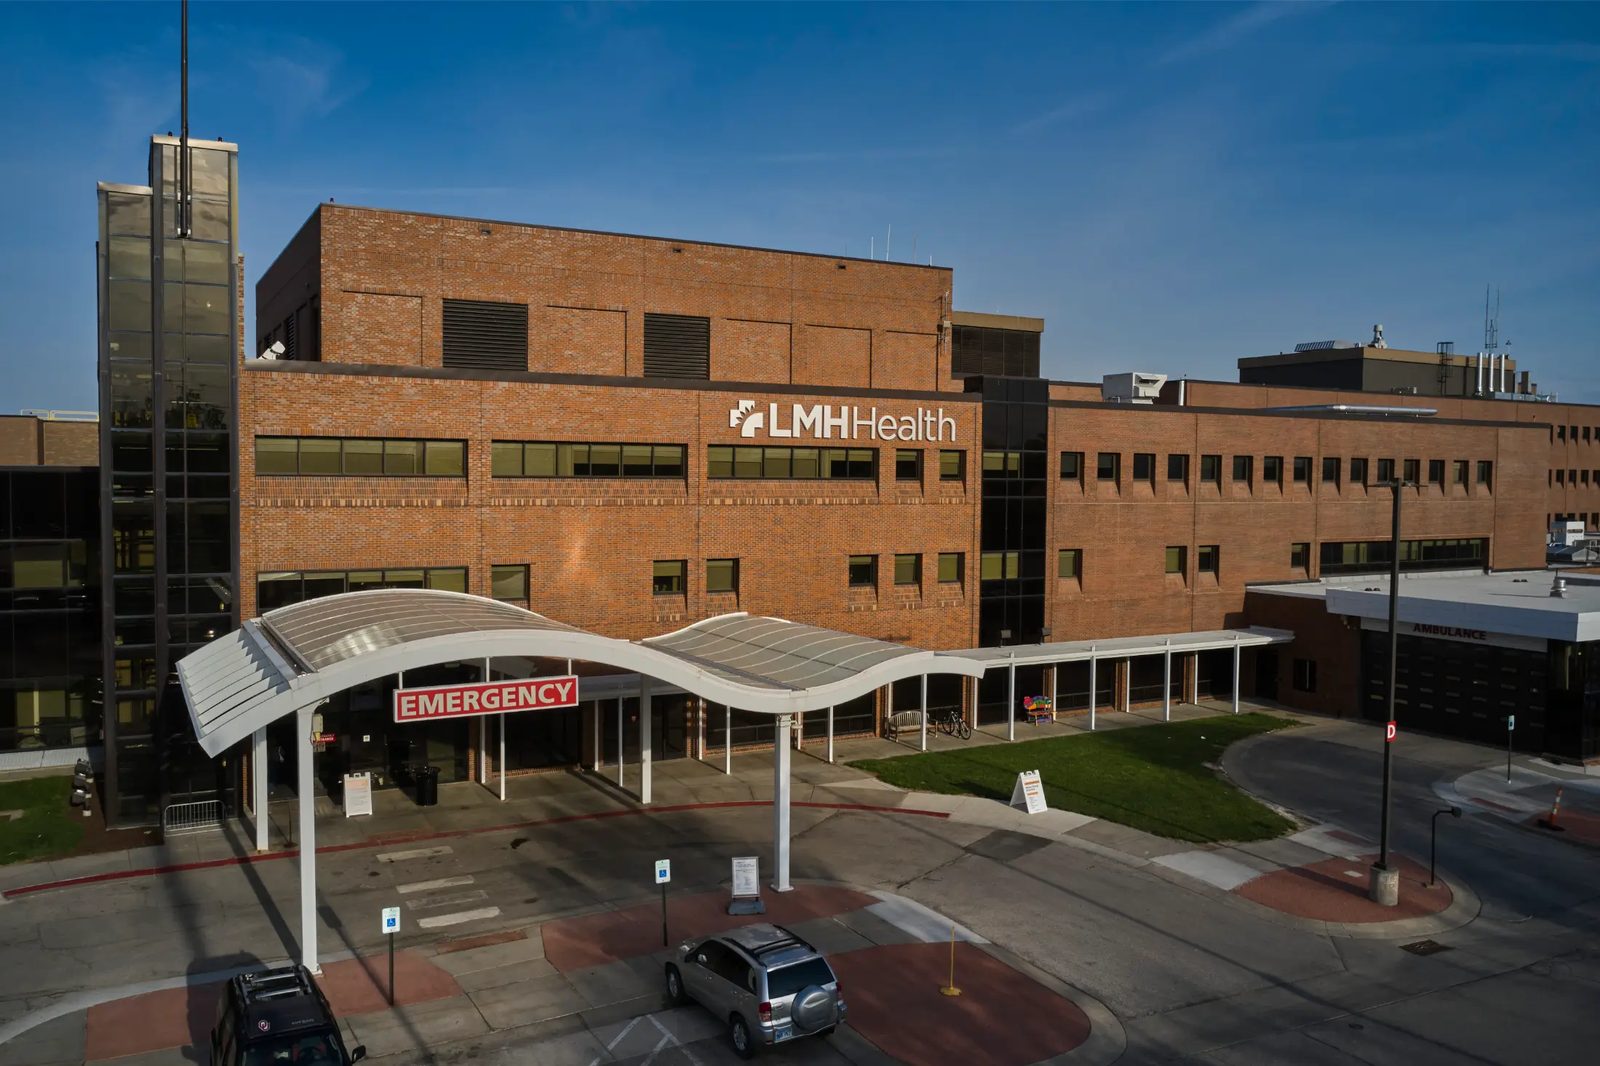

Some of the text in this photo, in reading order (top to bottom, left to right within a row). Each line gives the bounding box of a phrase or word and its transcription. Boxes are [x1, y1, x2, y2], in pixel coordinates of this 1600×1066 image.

[769, 403, 957, 442] LMH Health
[1413, 623, 1488, 640] AMBULANCE
[401, 681, 573, 717] EMERGENCY
[1387, 725, 1396, 739] D
